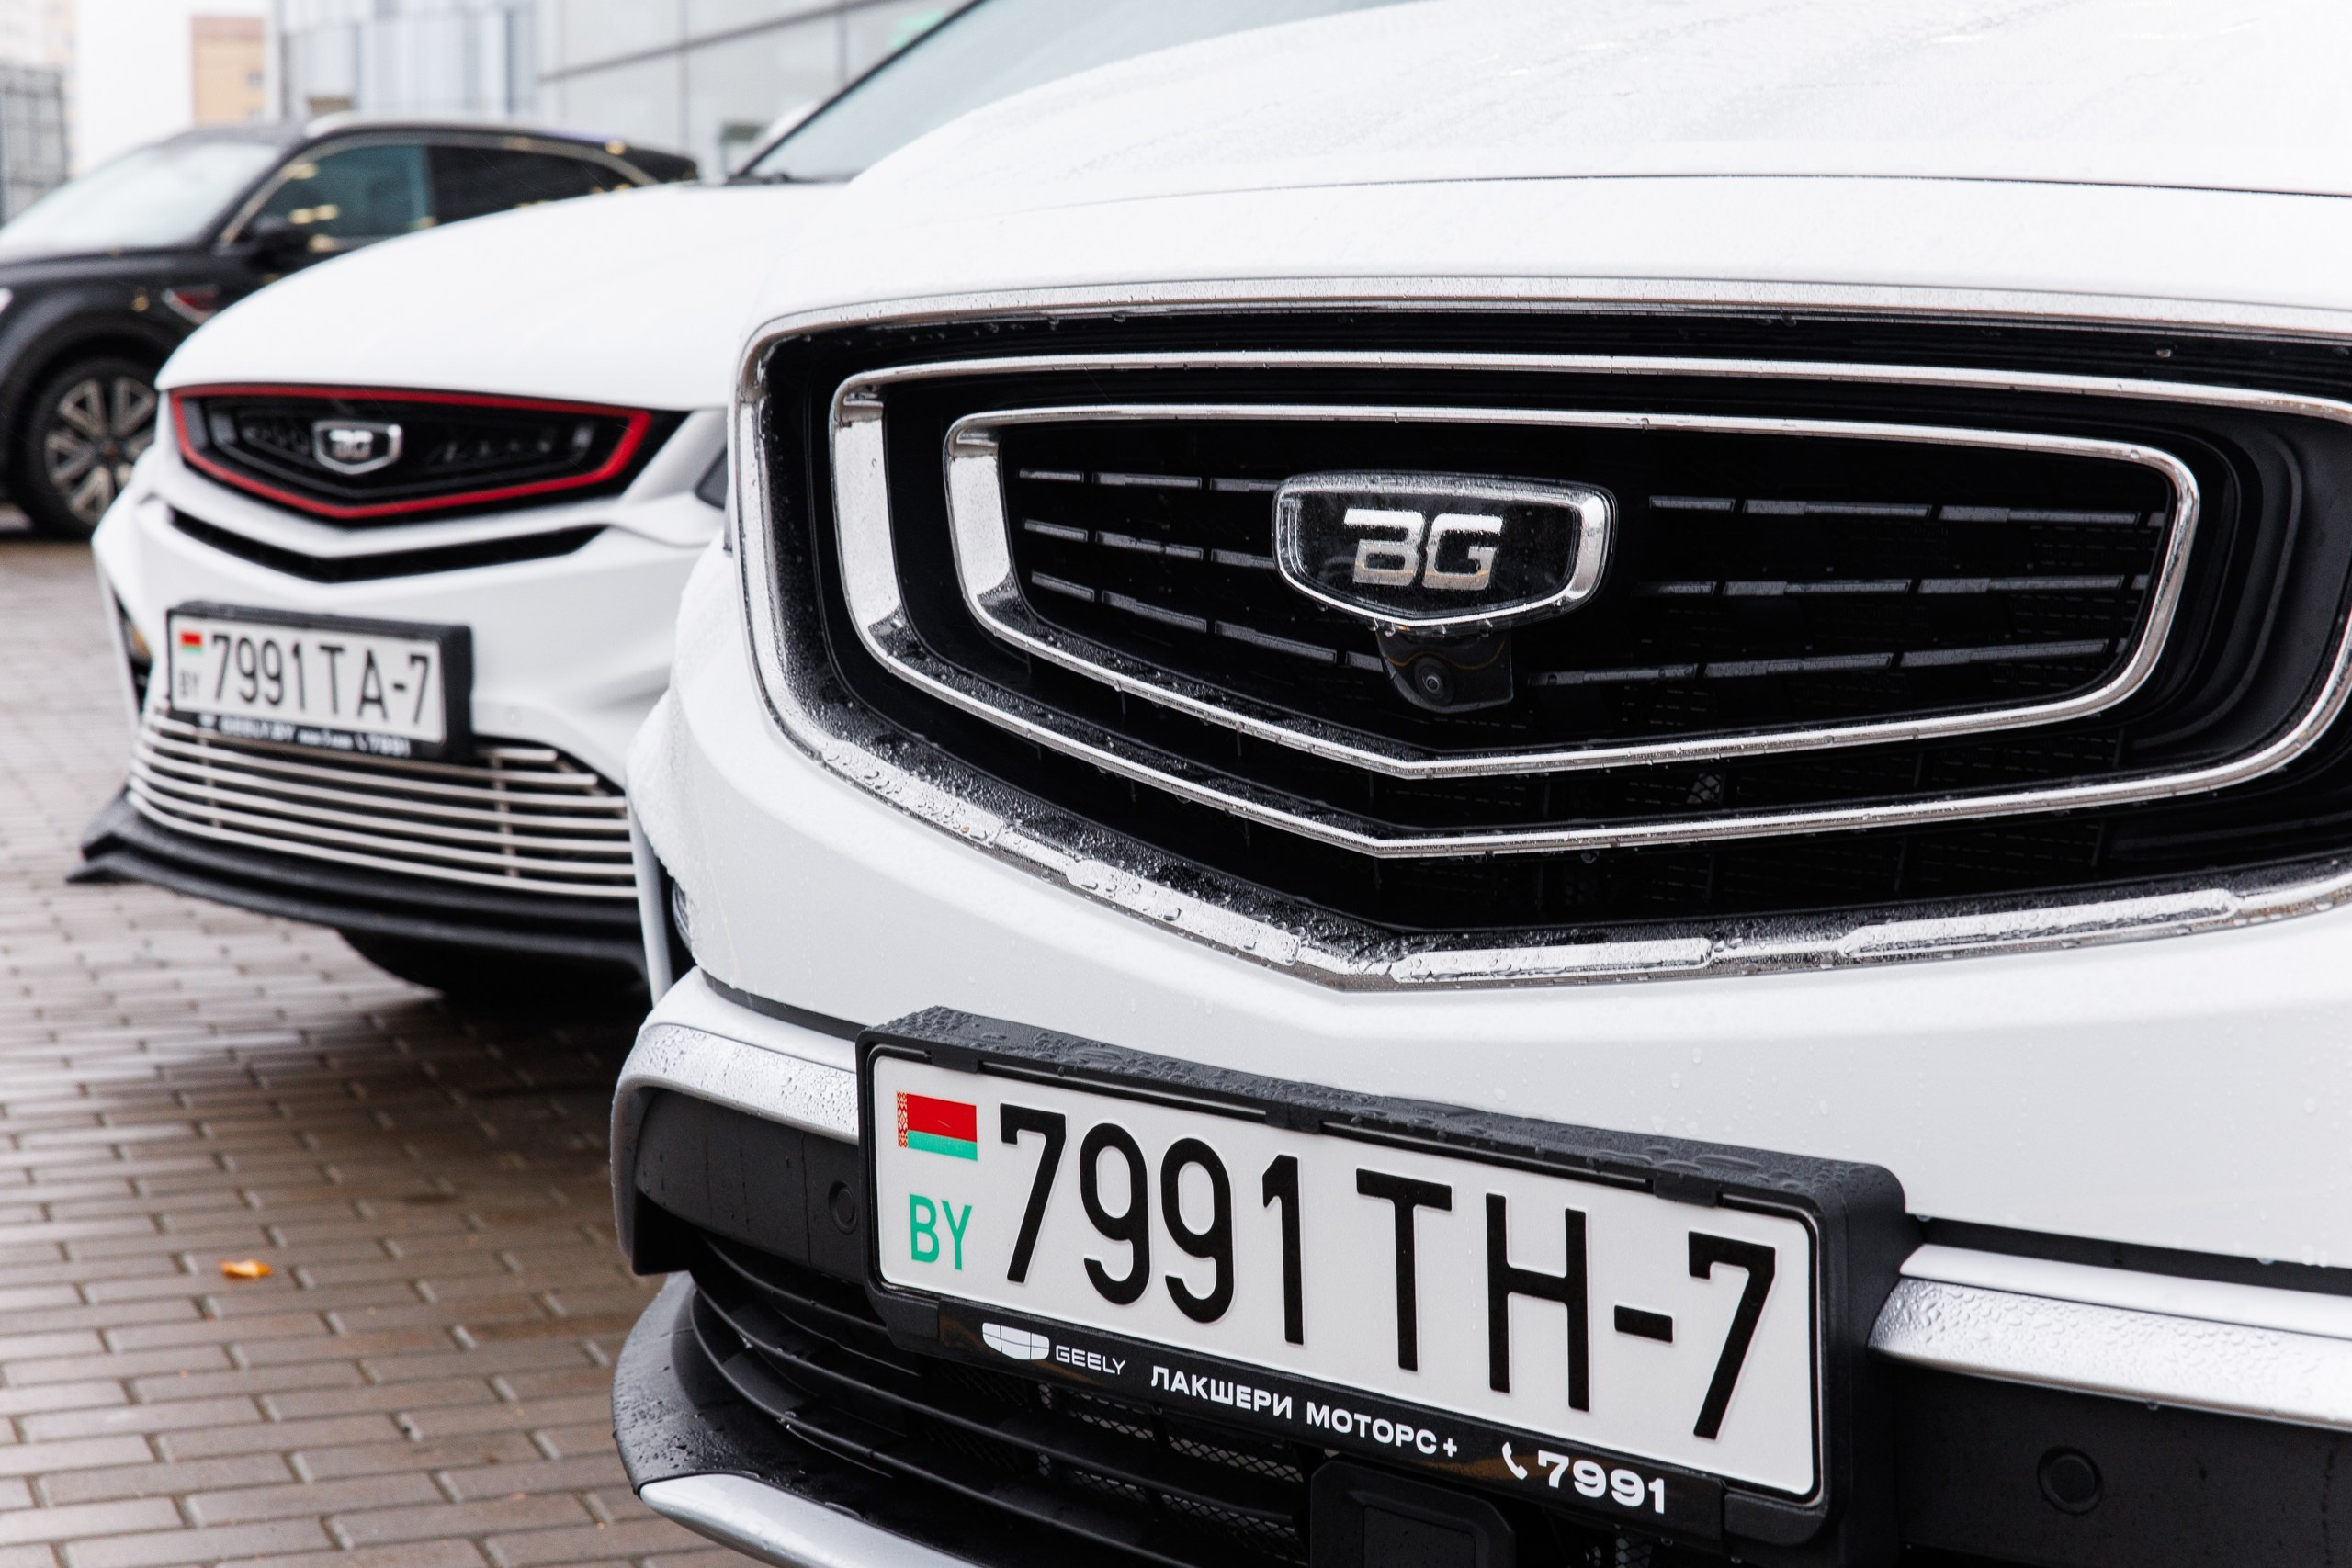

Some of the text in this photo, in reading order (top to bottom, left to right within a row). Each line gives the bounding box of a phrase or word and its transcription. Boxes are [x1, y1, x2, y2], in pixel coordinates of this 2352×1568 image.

[212, 633, 430, 726] 7991 TA-7
[909, 1193, 973, 1271] BY
[999, 1102, 1777, 1441] 7991 TH-7
[1055, 1344, 1126, 1376] GEELY
[1150, 1365, 1293, 1420] ЛАКШЕРИ
[1537, 1449, 1666, 1515] 7991
